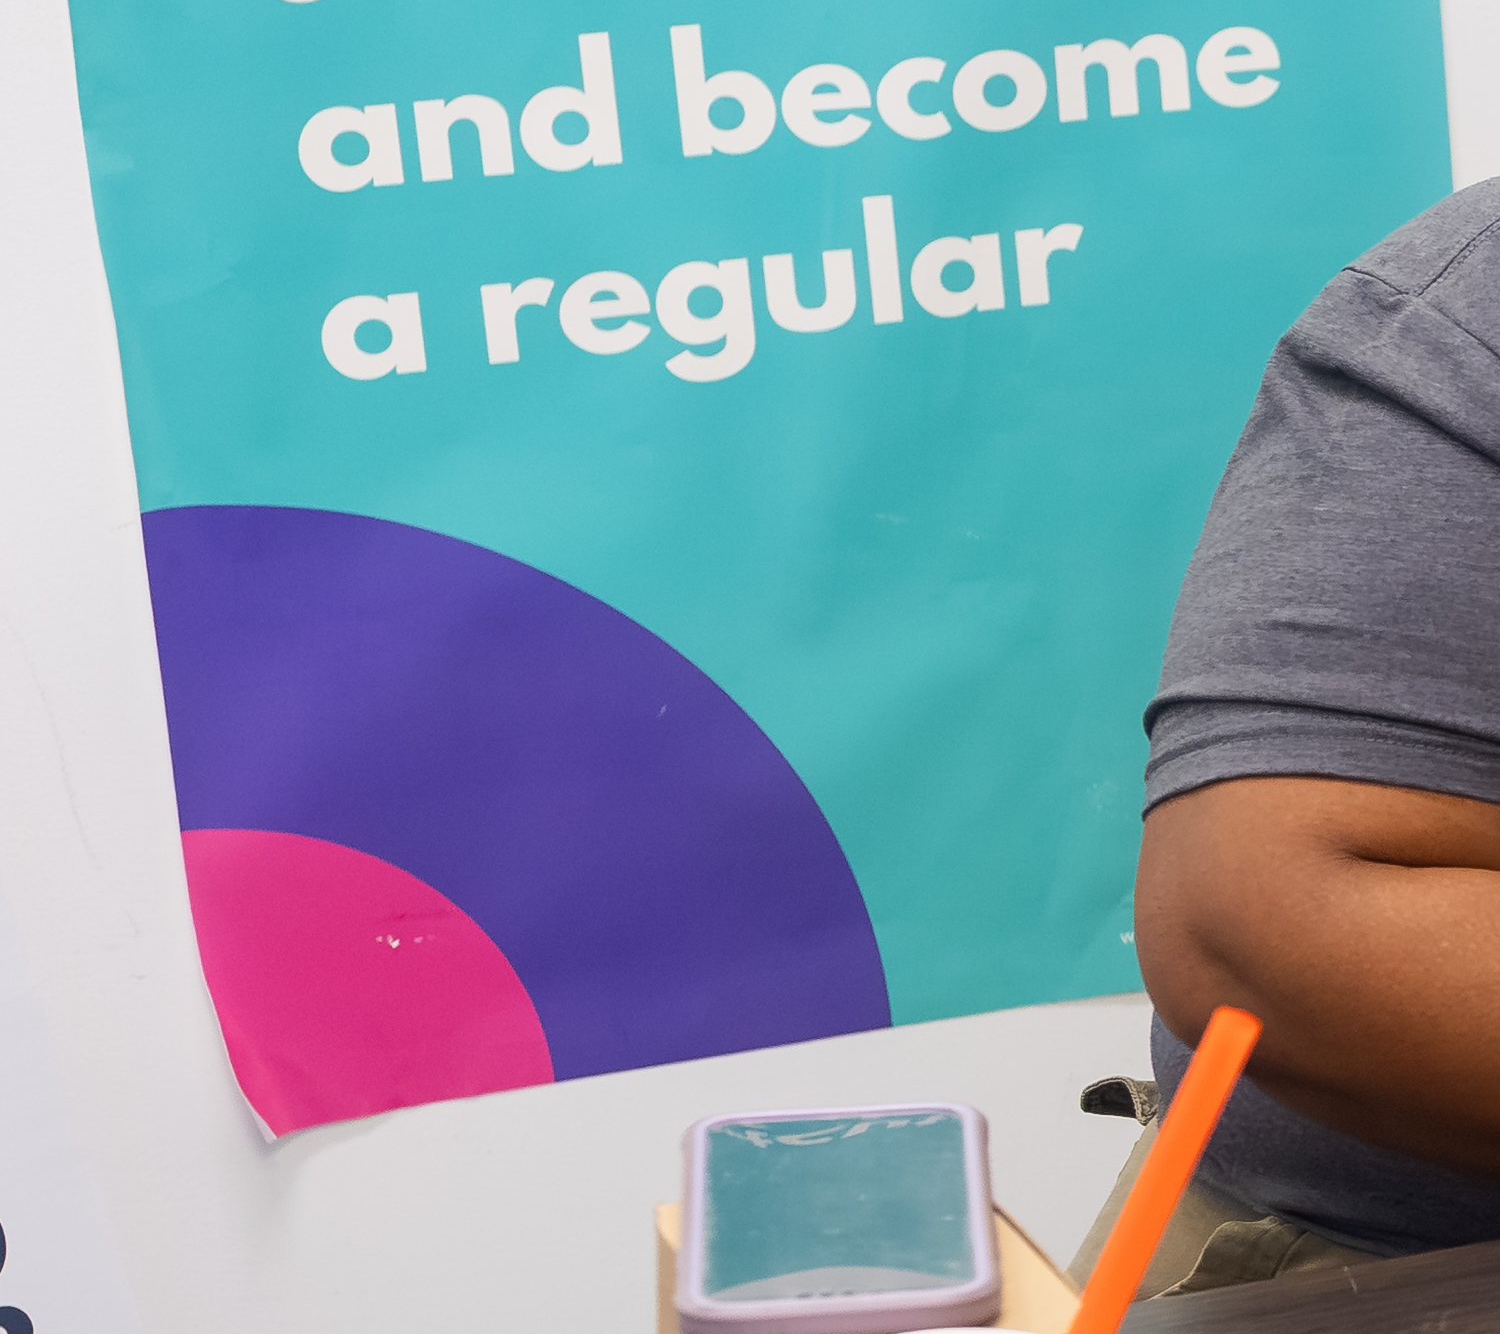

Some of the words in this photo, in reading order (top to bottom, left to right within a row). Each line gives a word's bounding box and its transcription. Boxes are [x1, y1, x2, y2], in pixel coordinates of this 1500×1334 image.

[297, 32, 624, 192] and
[669, 23, 1283, 158] become
[321, 290, 427, 383] a
[480, 194, 1084, 383] regular
